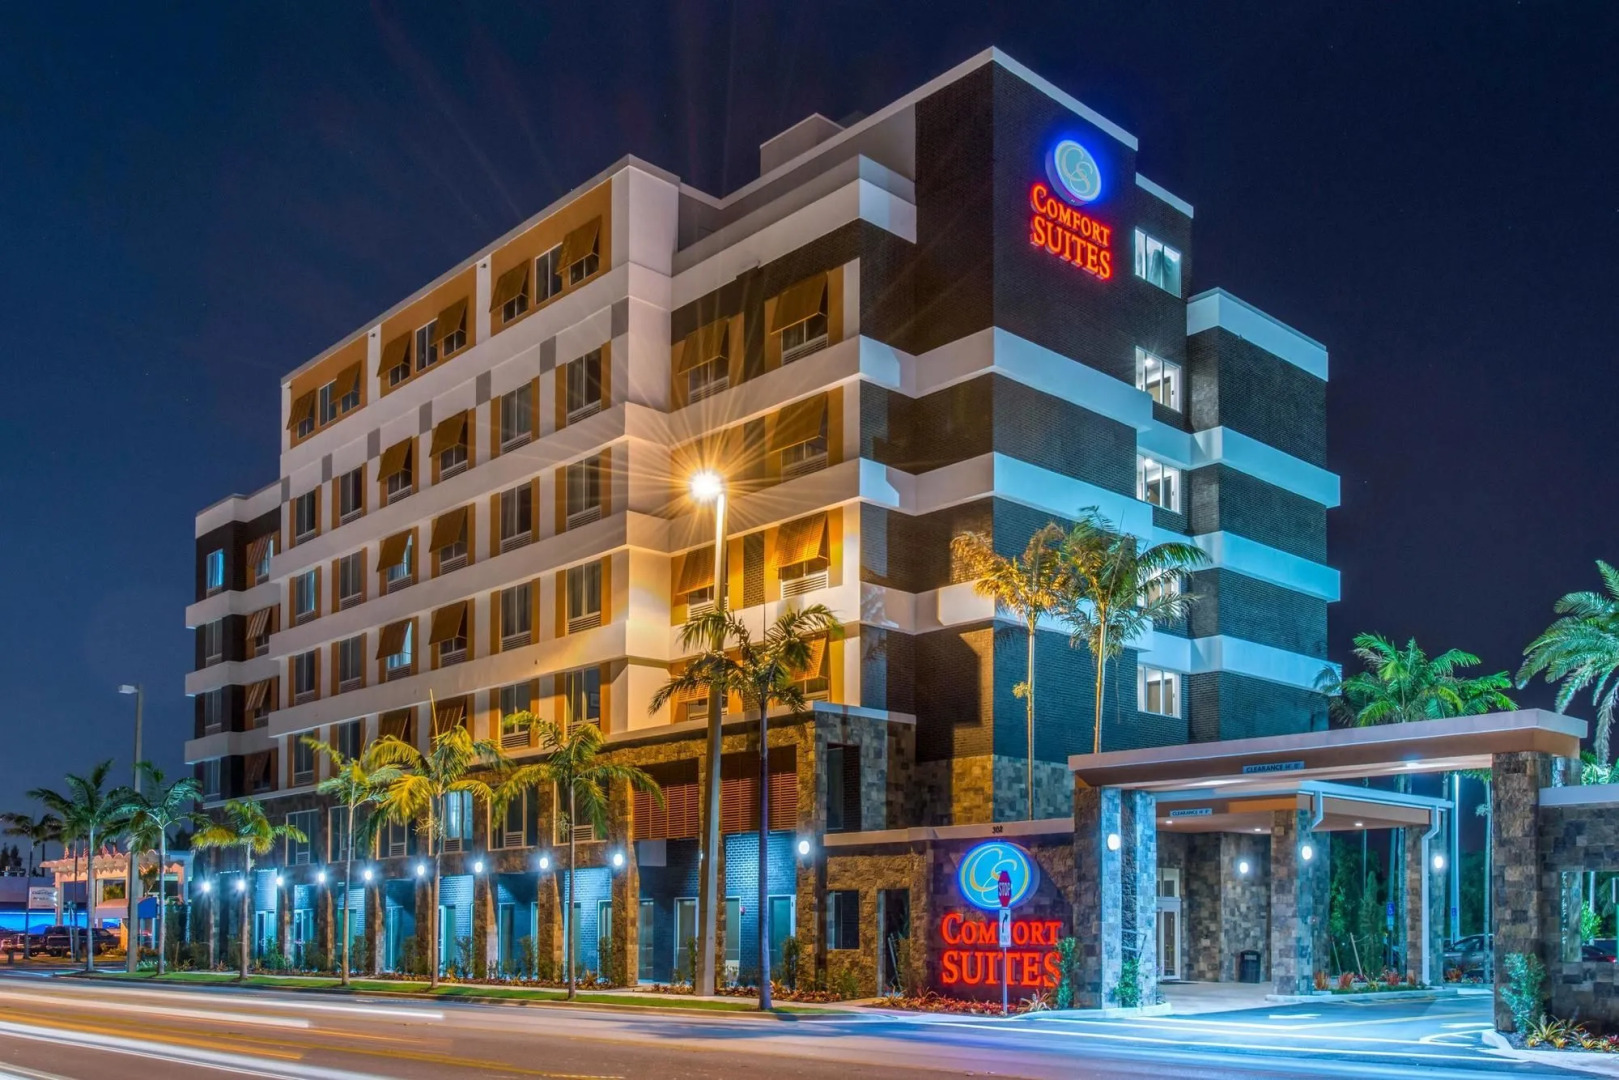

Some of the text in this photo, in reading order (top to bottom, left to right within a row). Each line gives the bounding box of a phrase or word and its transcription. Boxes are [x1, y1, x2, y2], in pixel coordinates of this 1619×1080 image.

[1032, 184, 1110, 246] COMFORT
[1033, 216, 1111, 279] SUITES
[1246, 764, 1283, 774] CLEARANCE
[999, 882, 1010, 897] STOP
[942, 912, 1062, 945] COMORT
[942, 950, 1062, 987] SUITES
